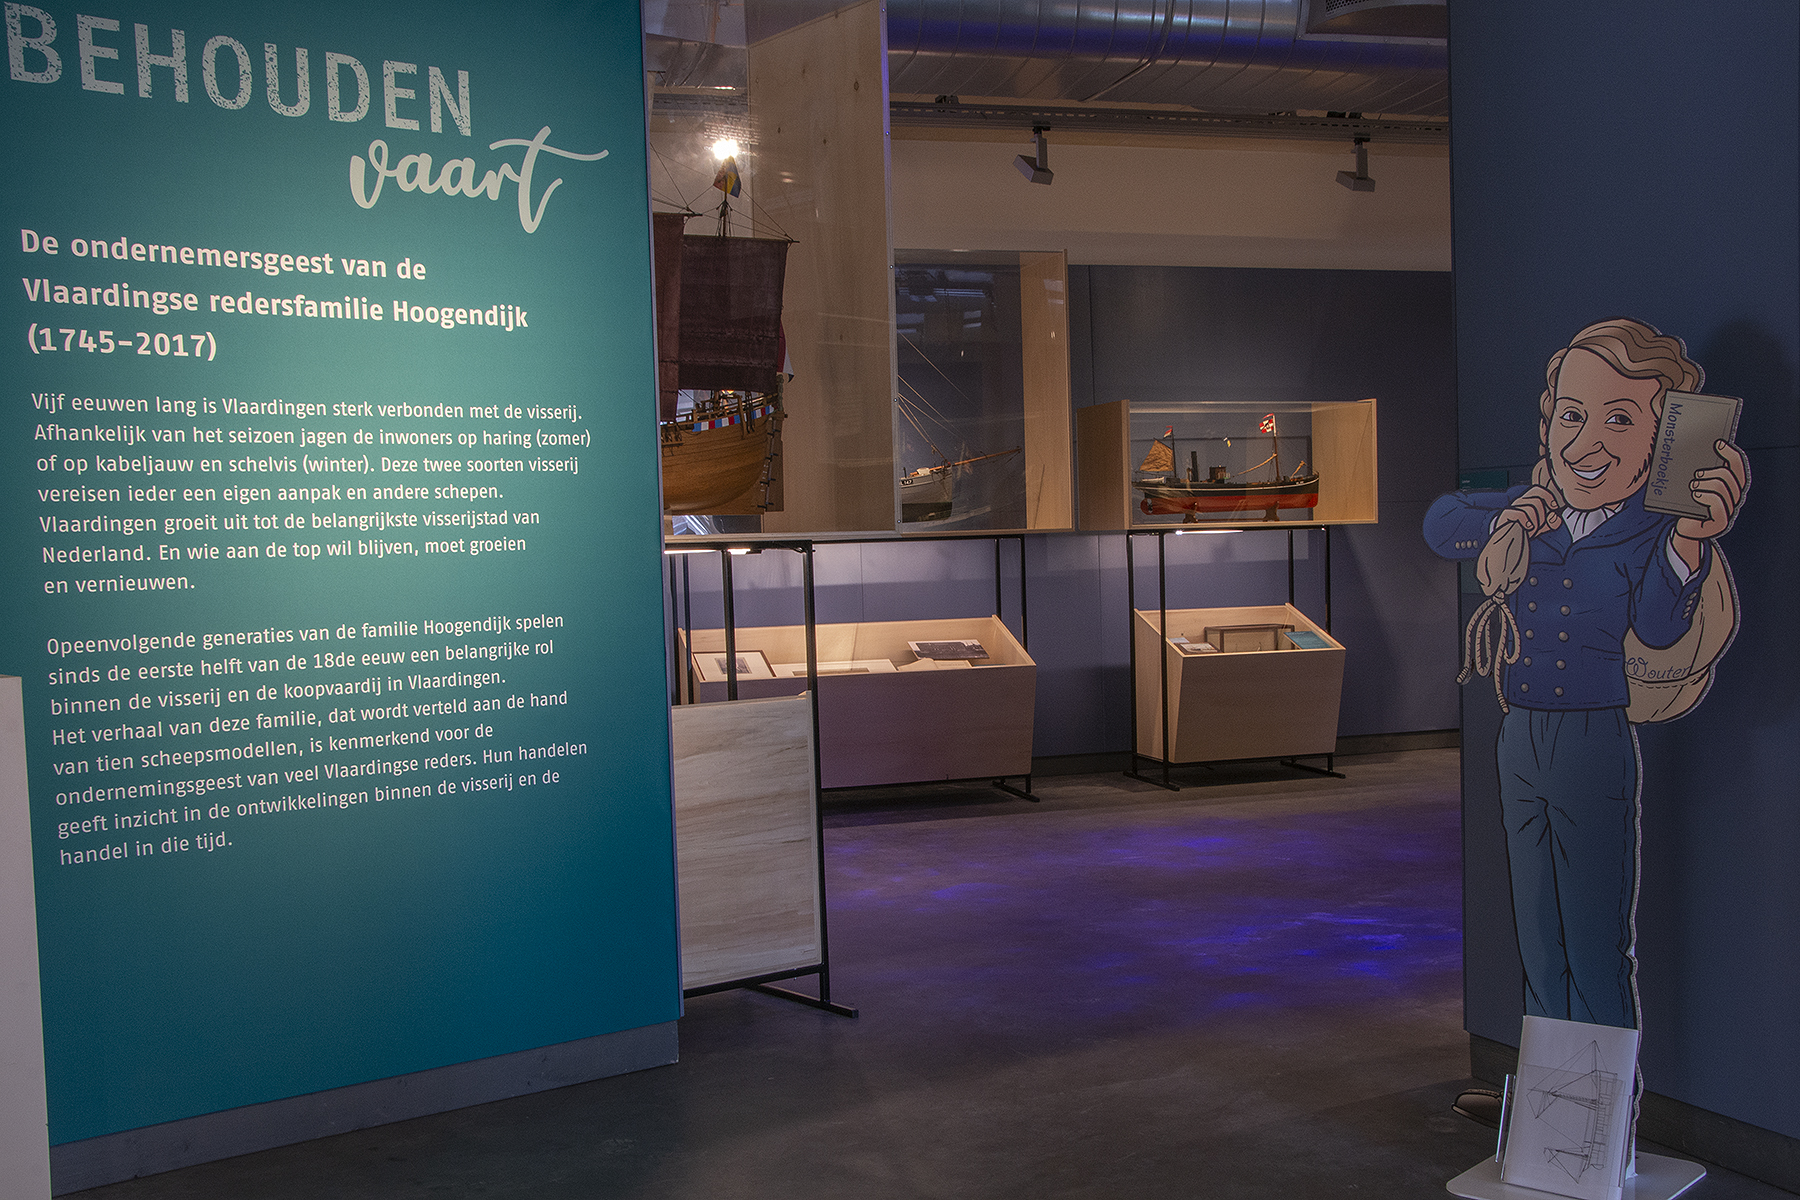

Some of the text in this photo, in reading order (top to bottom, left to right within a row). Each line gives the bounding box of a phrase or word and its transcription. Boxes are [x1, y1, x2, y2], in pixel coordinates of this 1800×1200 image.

[4, 2, 472, 136] BEHOUDEN
[350, 126, 609, 233] vaart
[20, 229, 426, 280] De ondernemersgeest van de
[21, 278, 528, 332] Vlaardingse redersfamilie Hoogendijk
[30, 393, 582, 423] Vijf eeuwen lang is Vlaardingen sterk verbonden met de visserij.
[33, 424, 591, 449] Afhankelijk van het seizoen jagen de inwoners op haring (zomer)
[1650, 402, 1684, 496] Monsterboekje
[35, 454, 578, 476] of op kabeljauw en schelvis (winter). Deze twee soorten visserij
[36, 484, 503, 505] vereisen ieder een eigen aanpak en andere schepen.
[38, 510, 539, 535] Vlaardingen groeit uit tot de belangrijkste visserijstad van
[41, 536, 526, 563] Nederland. En wie aan de top wil blijven, moet groeien
[43, 575, 195, 594] en vernieuwen.
[46, 614, 563, 658] Opeenvolgende generaties van de familie Hoogendijk spelen
[47, 639, 553, 685] sinds de eerste helft van de 18de eeuw een belangrijke rol
[1625, 657, 1691, 679] Wouter
[50, 672, 505, 715] binnen de visserij en de koopvaardij in Vlaardingen.
[51, 690, 567, 745] Het verhaal van deze familie, dat wordt verteld aan de hand
[52, 723, 493, 775] van tien scheepsmodellen, is kenmerkend voor de
[55, 742, 587, 805] ondernemingsgeest van veel Vlaardingse reders. Hun handelen
[57, 769, 560, 839] geeft inzicht in de ontwikkelingen binnen de visserij en de
[59, 831, 232, 865] handel in die tijd.
